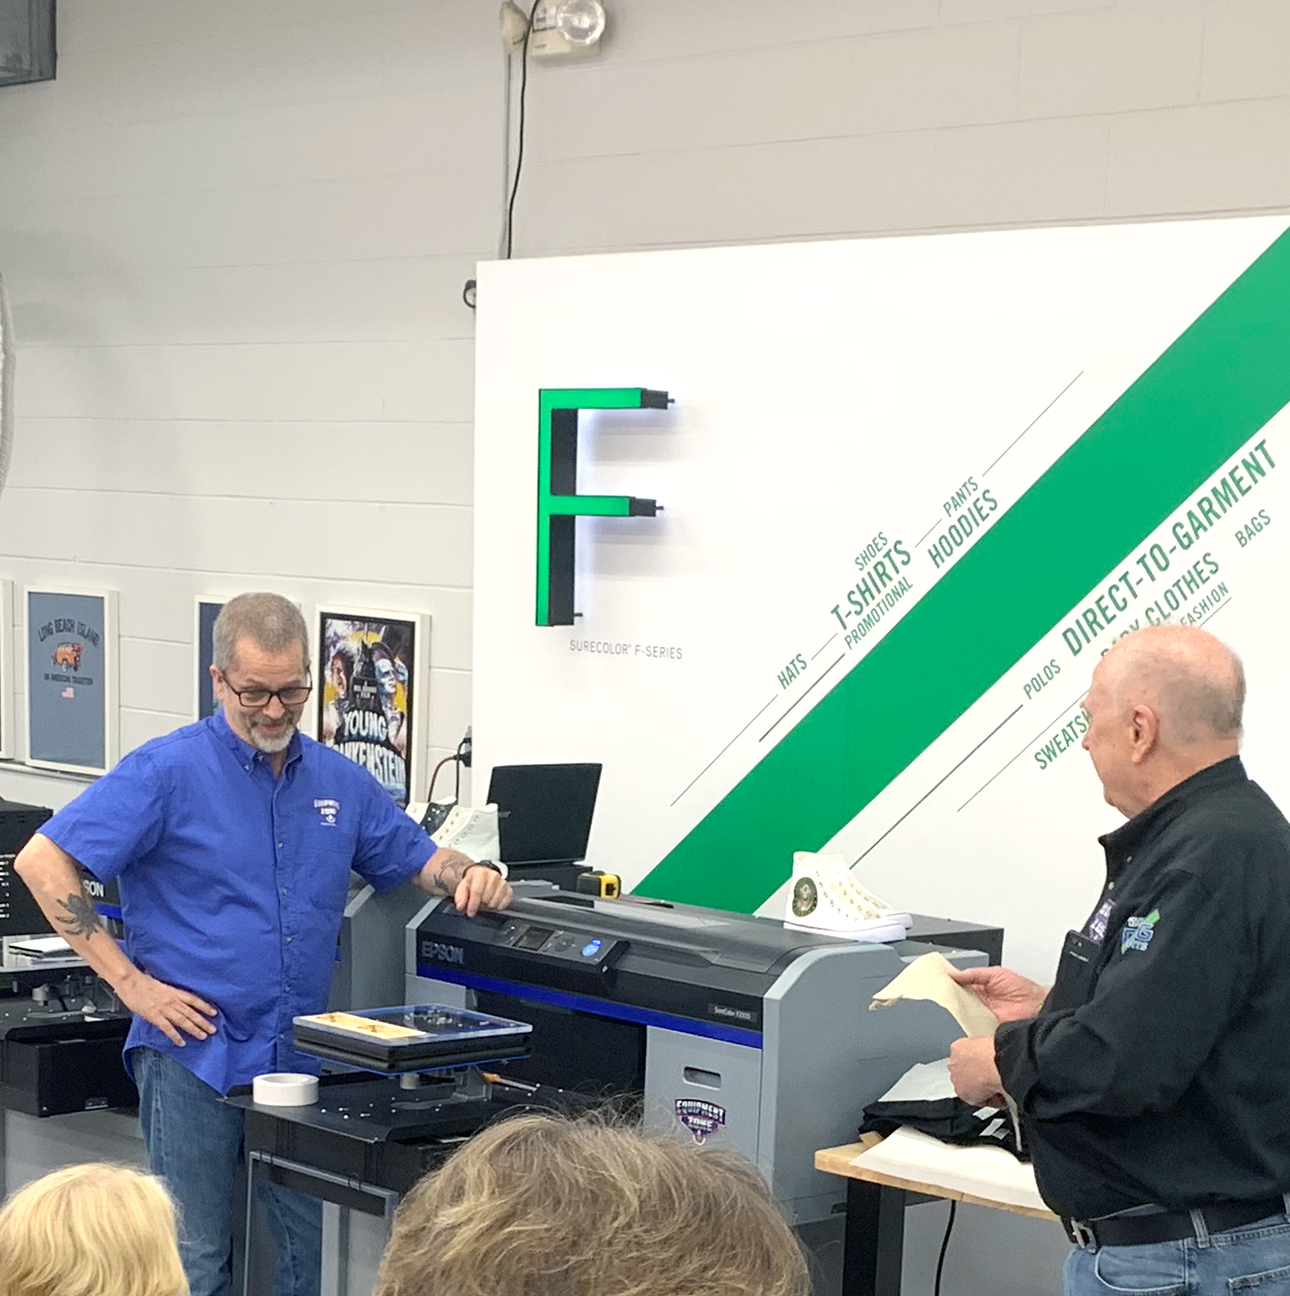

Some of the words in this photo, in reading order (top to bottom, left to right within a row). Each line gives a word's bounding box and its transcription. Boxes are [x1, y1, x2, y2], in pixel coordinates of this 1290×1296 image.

[943, 476, 979, 518] PANTS
[927, 488, 999, 569] HOODIES
[1061, 439, 1277, 657] DIRECT-TO-GARMENT
[1234, 508, 1272, 548] BAGS
[854, 531, 889, 572] SHOES
[830, 540, 912, 631] T-SHIRTS
[1145, 551, 1221, 628] CLOTHES
[37, 621, 53, 641] LONG
[54, 618, 75, 634] BEACH
[843, 576, 914, 650] PROMOTIONAL
[635, 644, 683, 660] F-SERIES
[776, 653, 808, 690] HATS
[1022, 658, 1062, 701] POLOS
[344, 709, 388, 742] YOUNG
[82, 879, 105, 898] SON
[422, 940, 464, 965] EPSON
